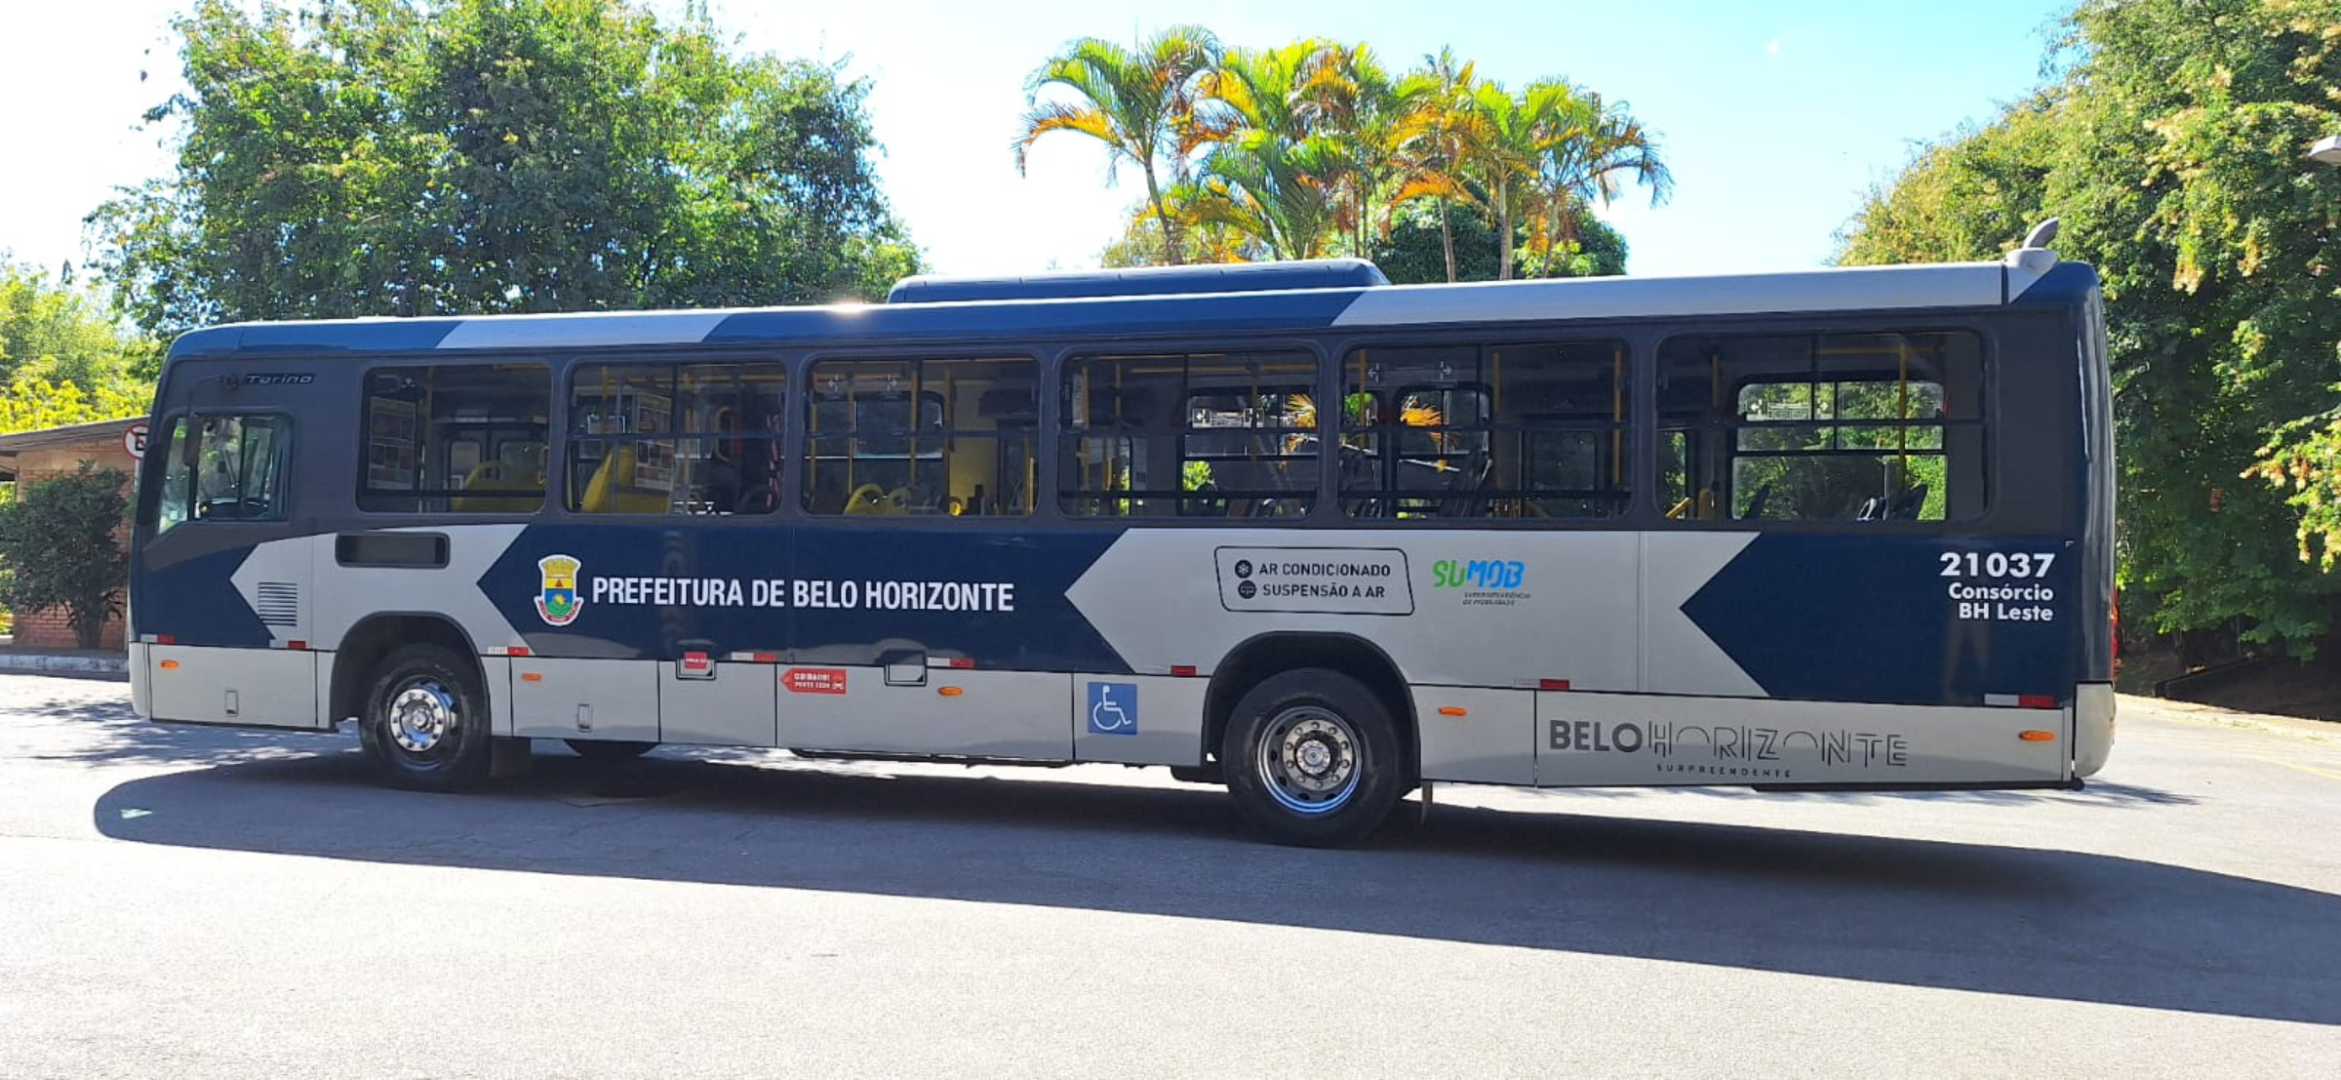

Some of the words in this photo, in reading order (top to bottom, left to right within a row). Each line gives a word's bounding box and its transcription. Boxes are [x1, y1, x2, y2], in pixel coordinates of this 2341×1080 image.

[247, 374, 313, 384] Torino
[1259, 562, 1278, 575] AR
[1282, 563, 1391, 577] CONDICIONADO
[1432, 560, 1525, 588] SUMOB
[1940, 552, 2056, 578] 21037
[592, 577, 744, 607] PREFEITURA
[751, 579, 785, 607] DE
[793, 580, 858, 609] BELO
[865, 580, 1015, 611] HORIZONTE
[1262, 582, 1348, 598] SUSPENSÃO
[1352, 586, 1362, 598] A
[1365, 586, 1386, 598] AR
[1948, 581, 2054, 601] Consórcio
[1958, 602, 1990, 620] BH
[1997, 603, 2054, 621] Leste
